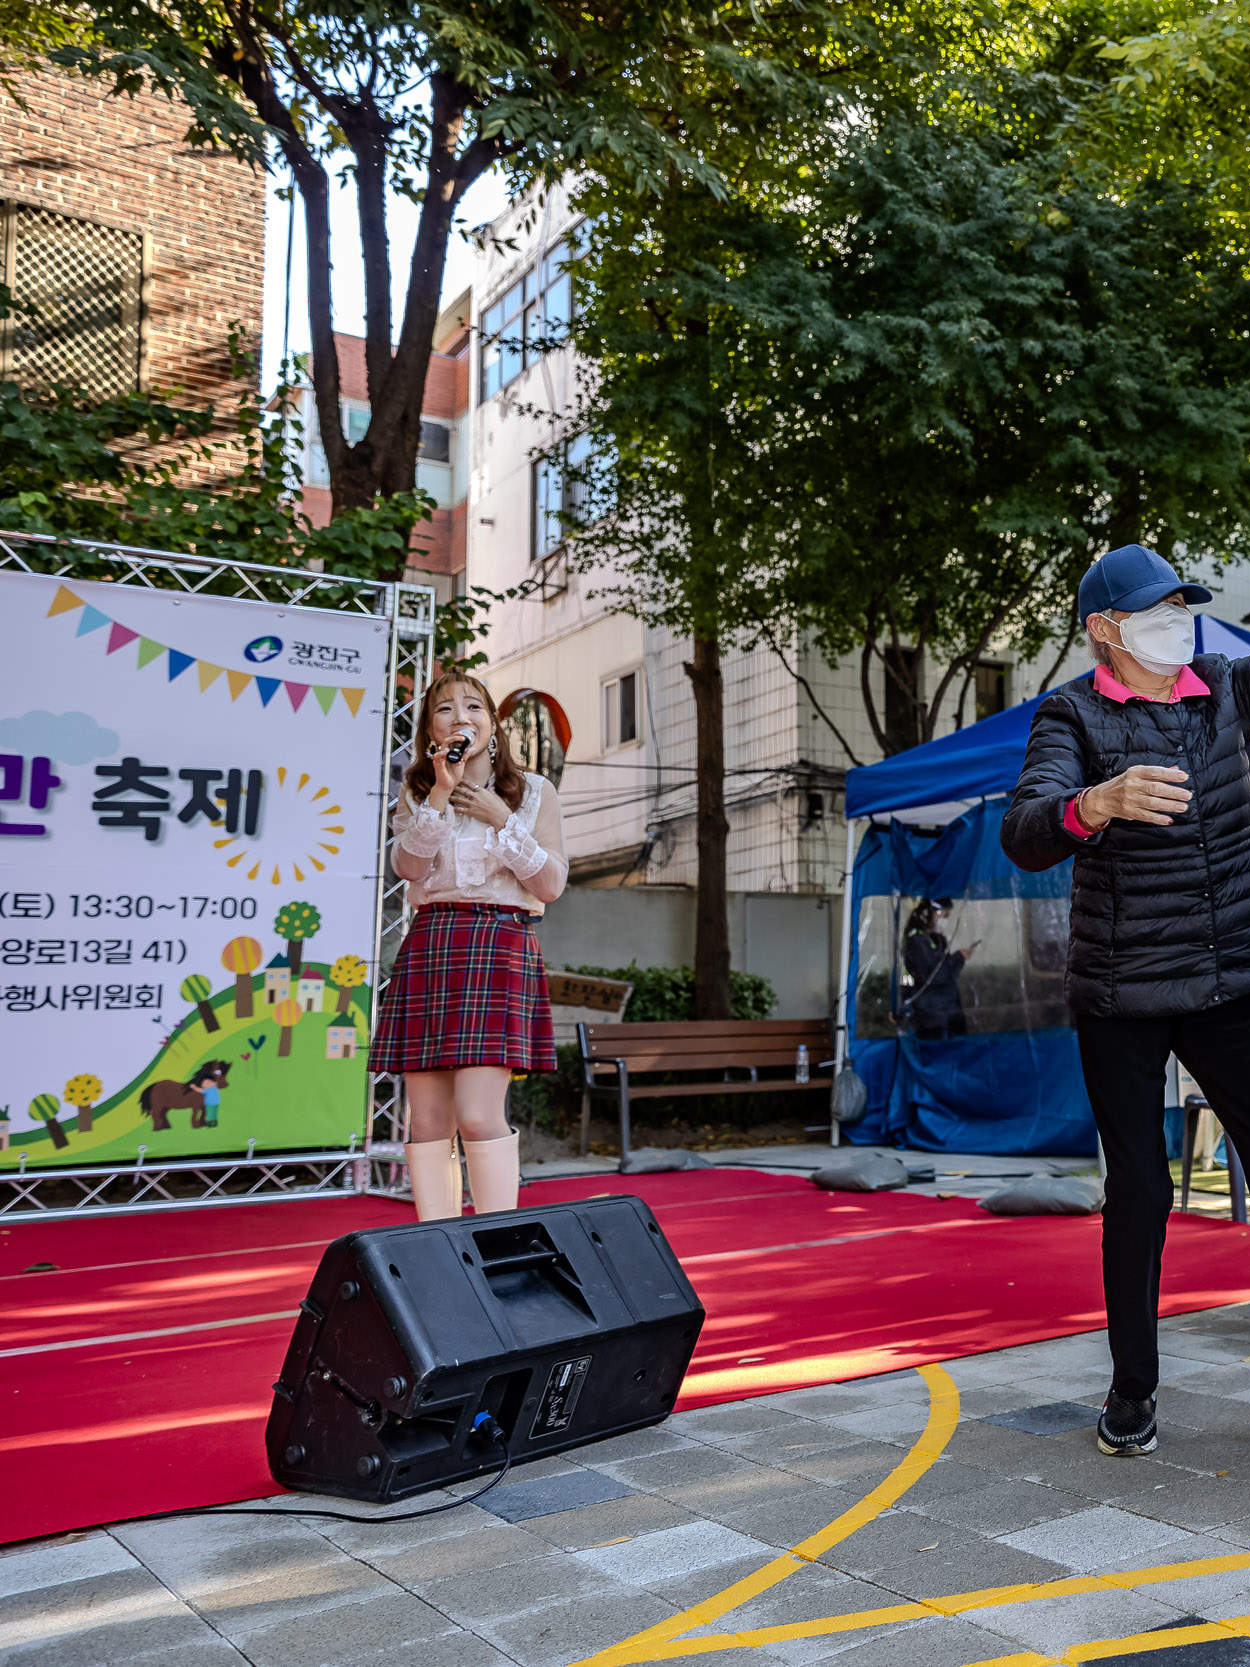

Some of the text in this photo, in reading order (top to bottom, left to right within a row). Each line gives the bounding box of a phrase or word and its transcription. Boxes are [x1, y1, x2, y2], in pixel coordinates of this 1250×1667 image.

[291, 641, 361, 663] 광진구
[92, 757, 264, 841] 축제
[0, 892, 258, 920] (토) 13:30~17:00
[0, 938, 188, 965] 양로13길 41)
[0, 984, 163, 1011] 행사위원회
